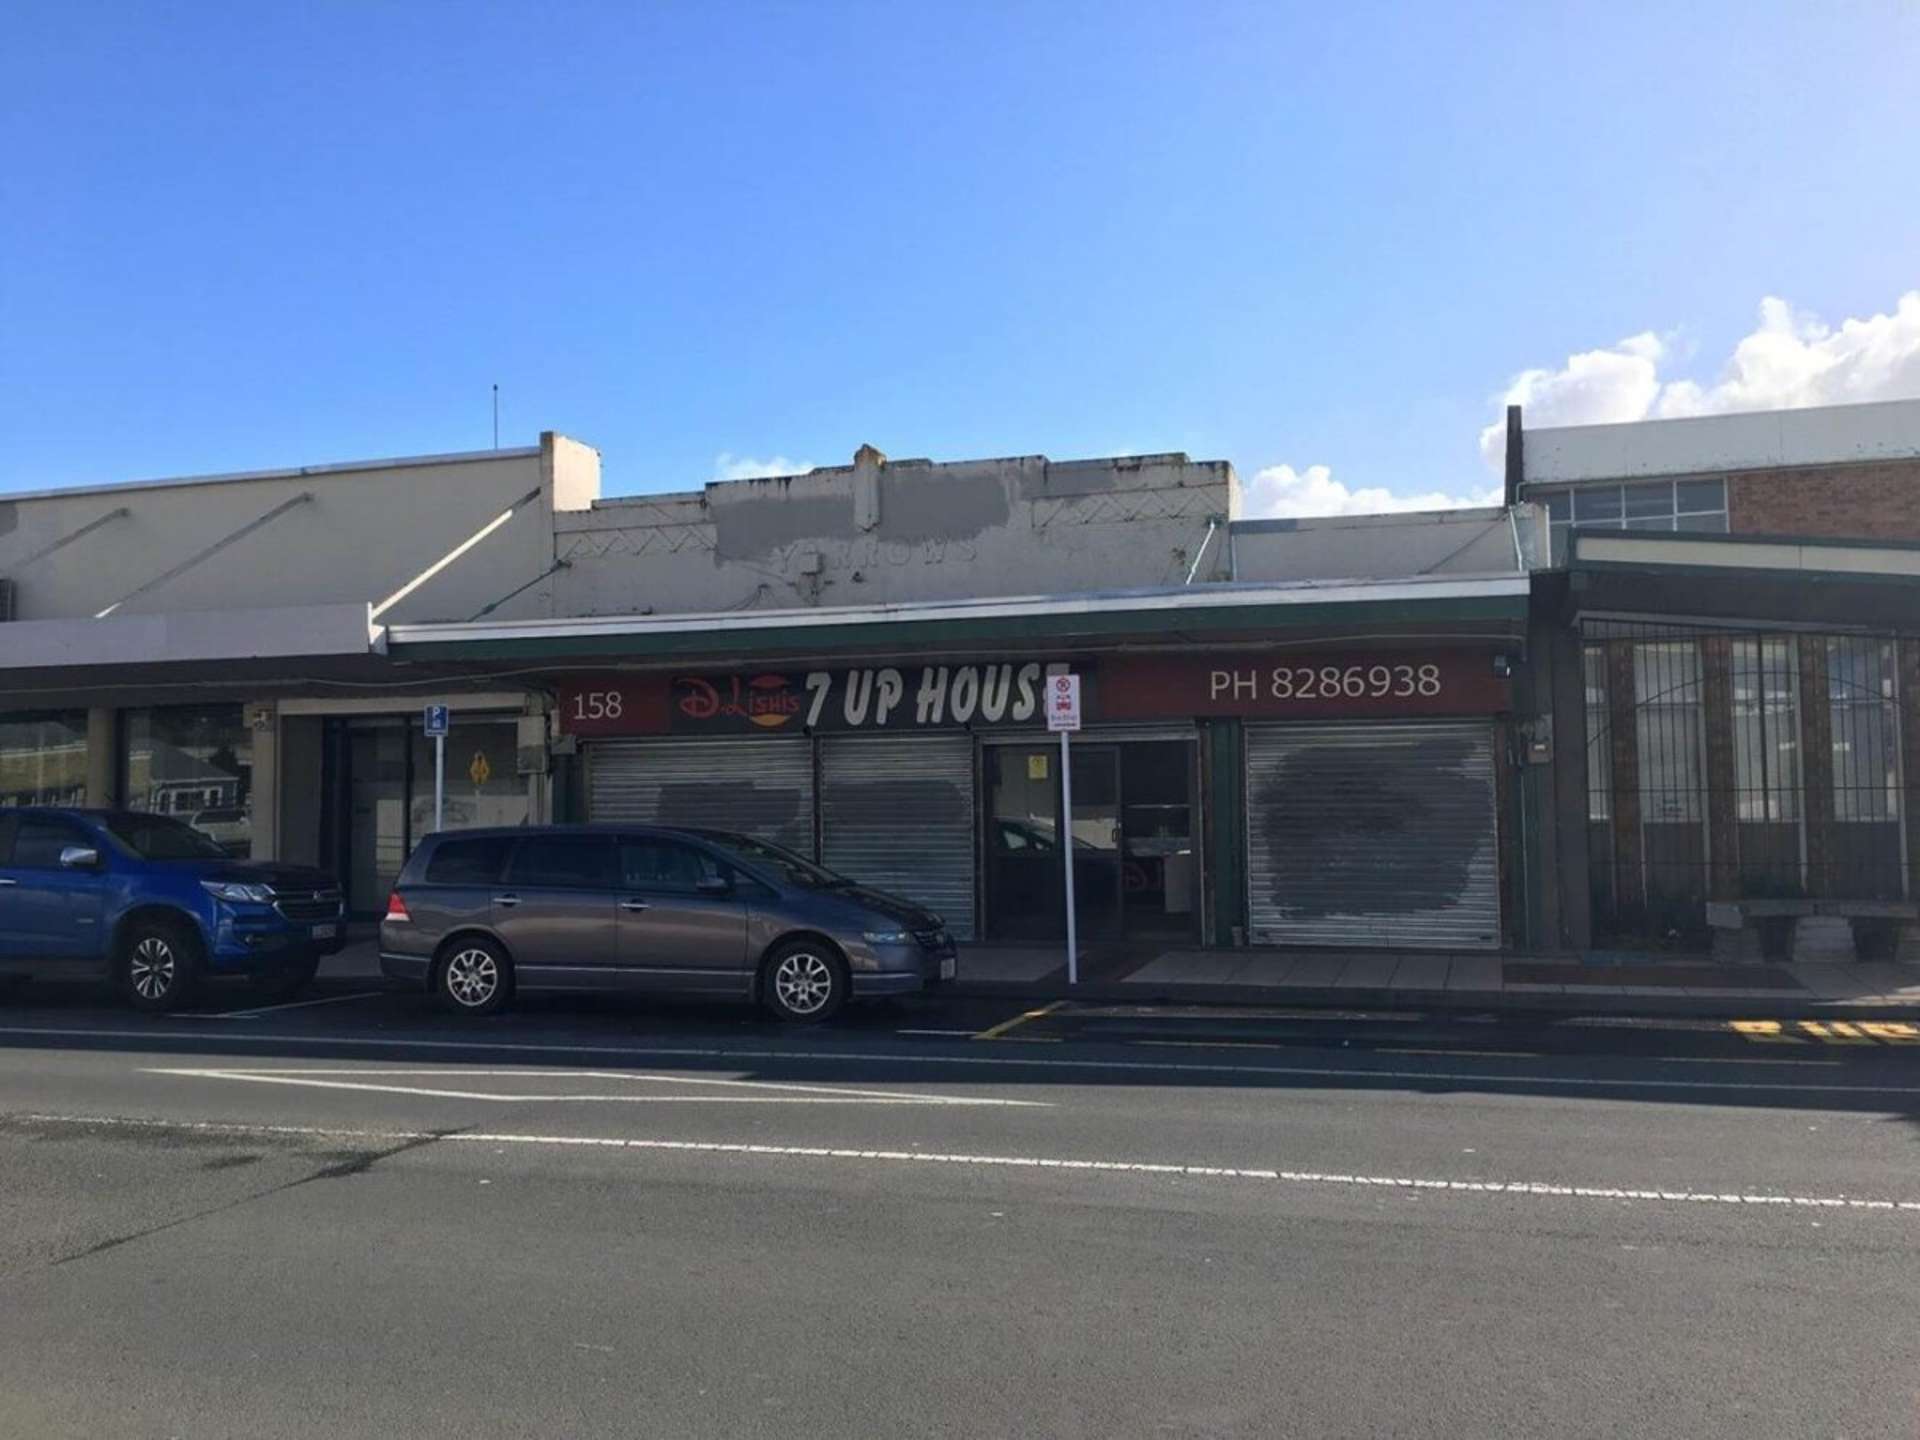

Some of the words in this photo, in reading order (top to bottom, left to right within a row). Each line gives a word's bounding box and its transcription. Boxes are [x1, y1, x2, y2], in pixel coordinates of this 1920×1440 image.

[805, 672, 832, 726] 7
[844, 668, 903, 726] UP
[1211, 670, 1257, 699] PH
[1271, 665, 1441, 698] 8286938
[574, 691, 622, 719] 158
